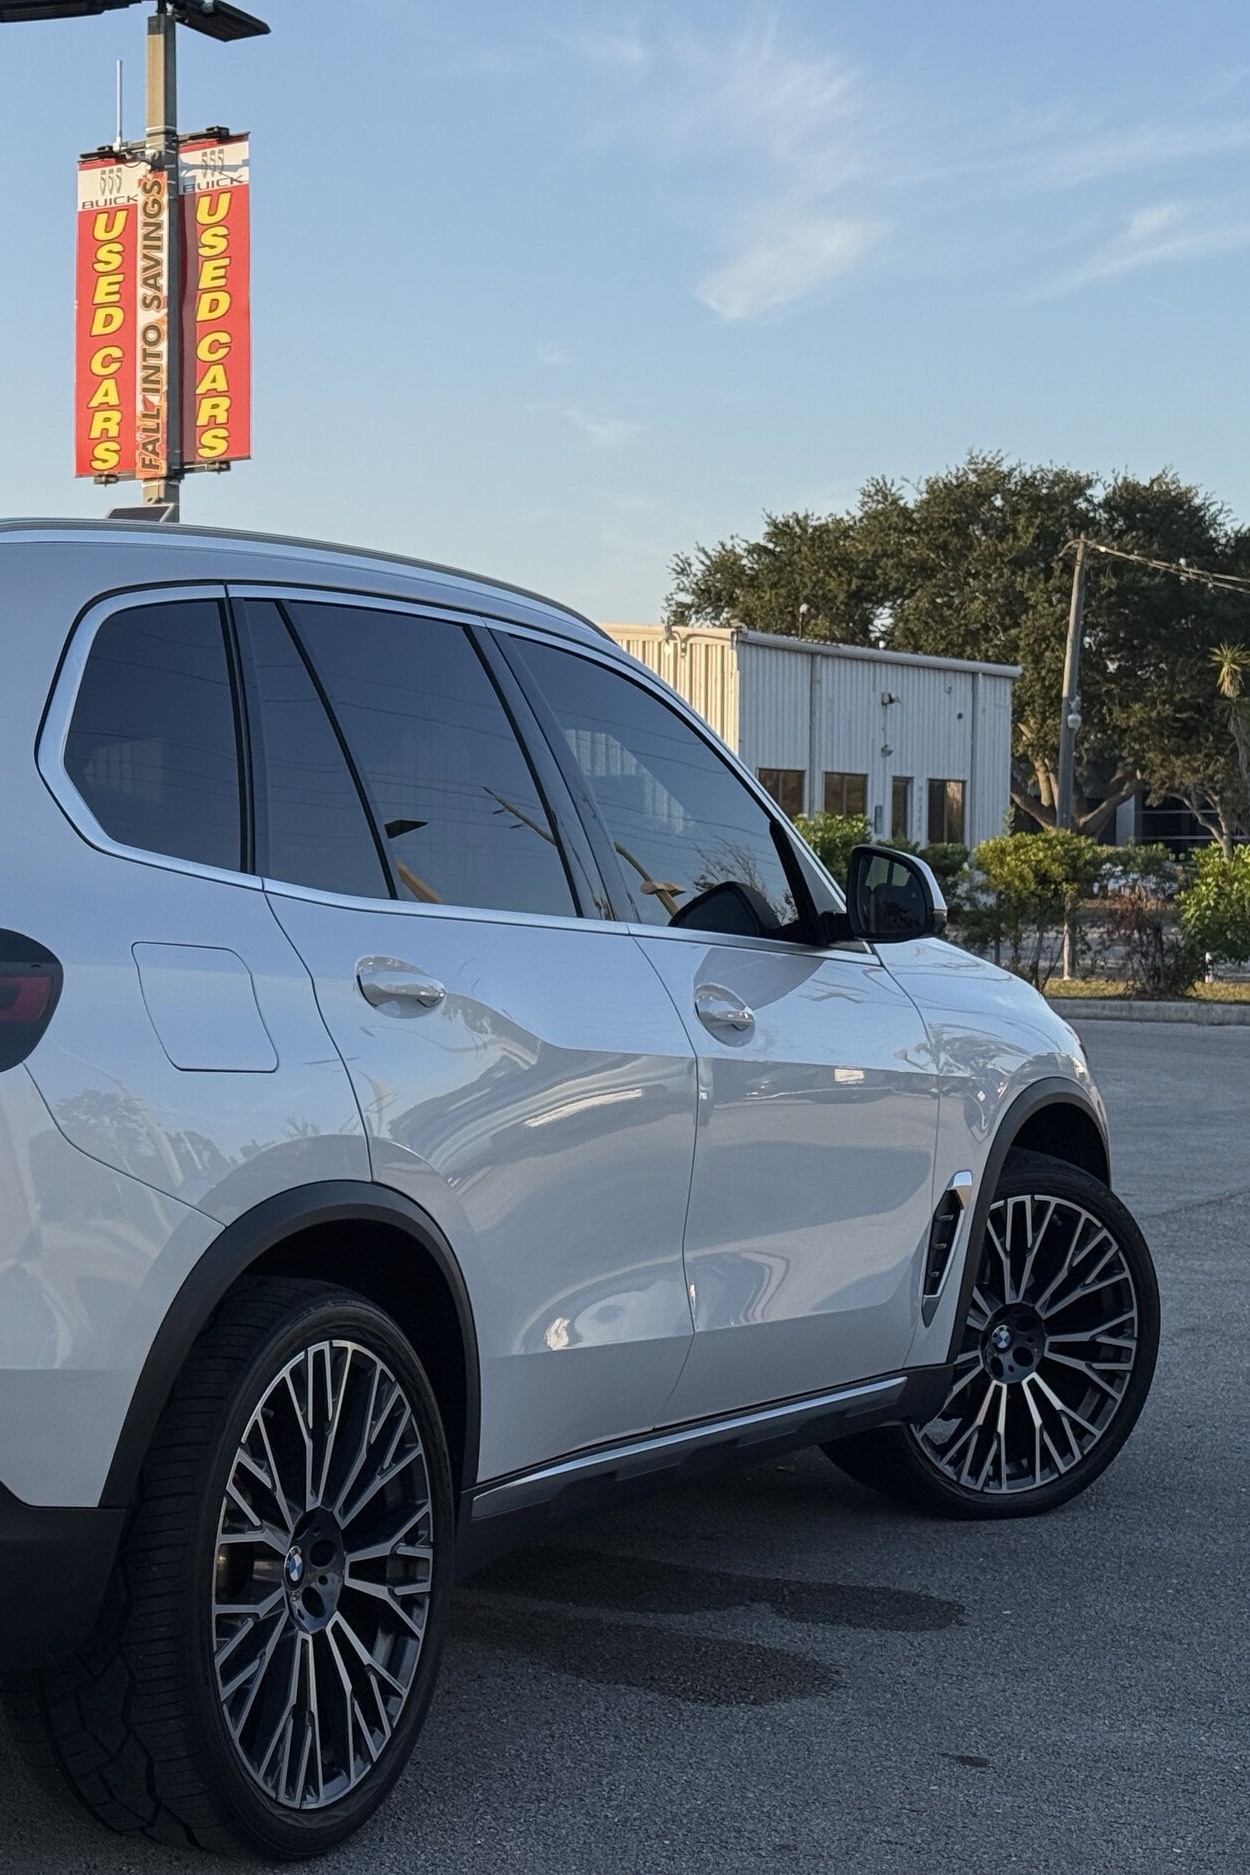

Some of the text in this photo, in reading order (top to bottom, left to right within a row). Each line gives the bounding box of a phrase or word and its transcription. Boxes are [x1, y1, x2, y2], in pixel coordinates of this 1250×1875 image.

[81, 194, 139, 209] BUICK
[182, 175, 245, 193] BUICK
[87, 208, 129, 472] USED CARS
[140, 178, 163, 471] FALL INTO SAVINGS
[194, 190, 232, 459] USED CARS
